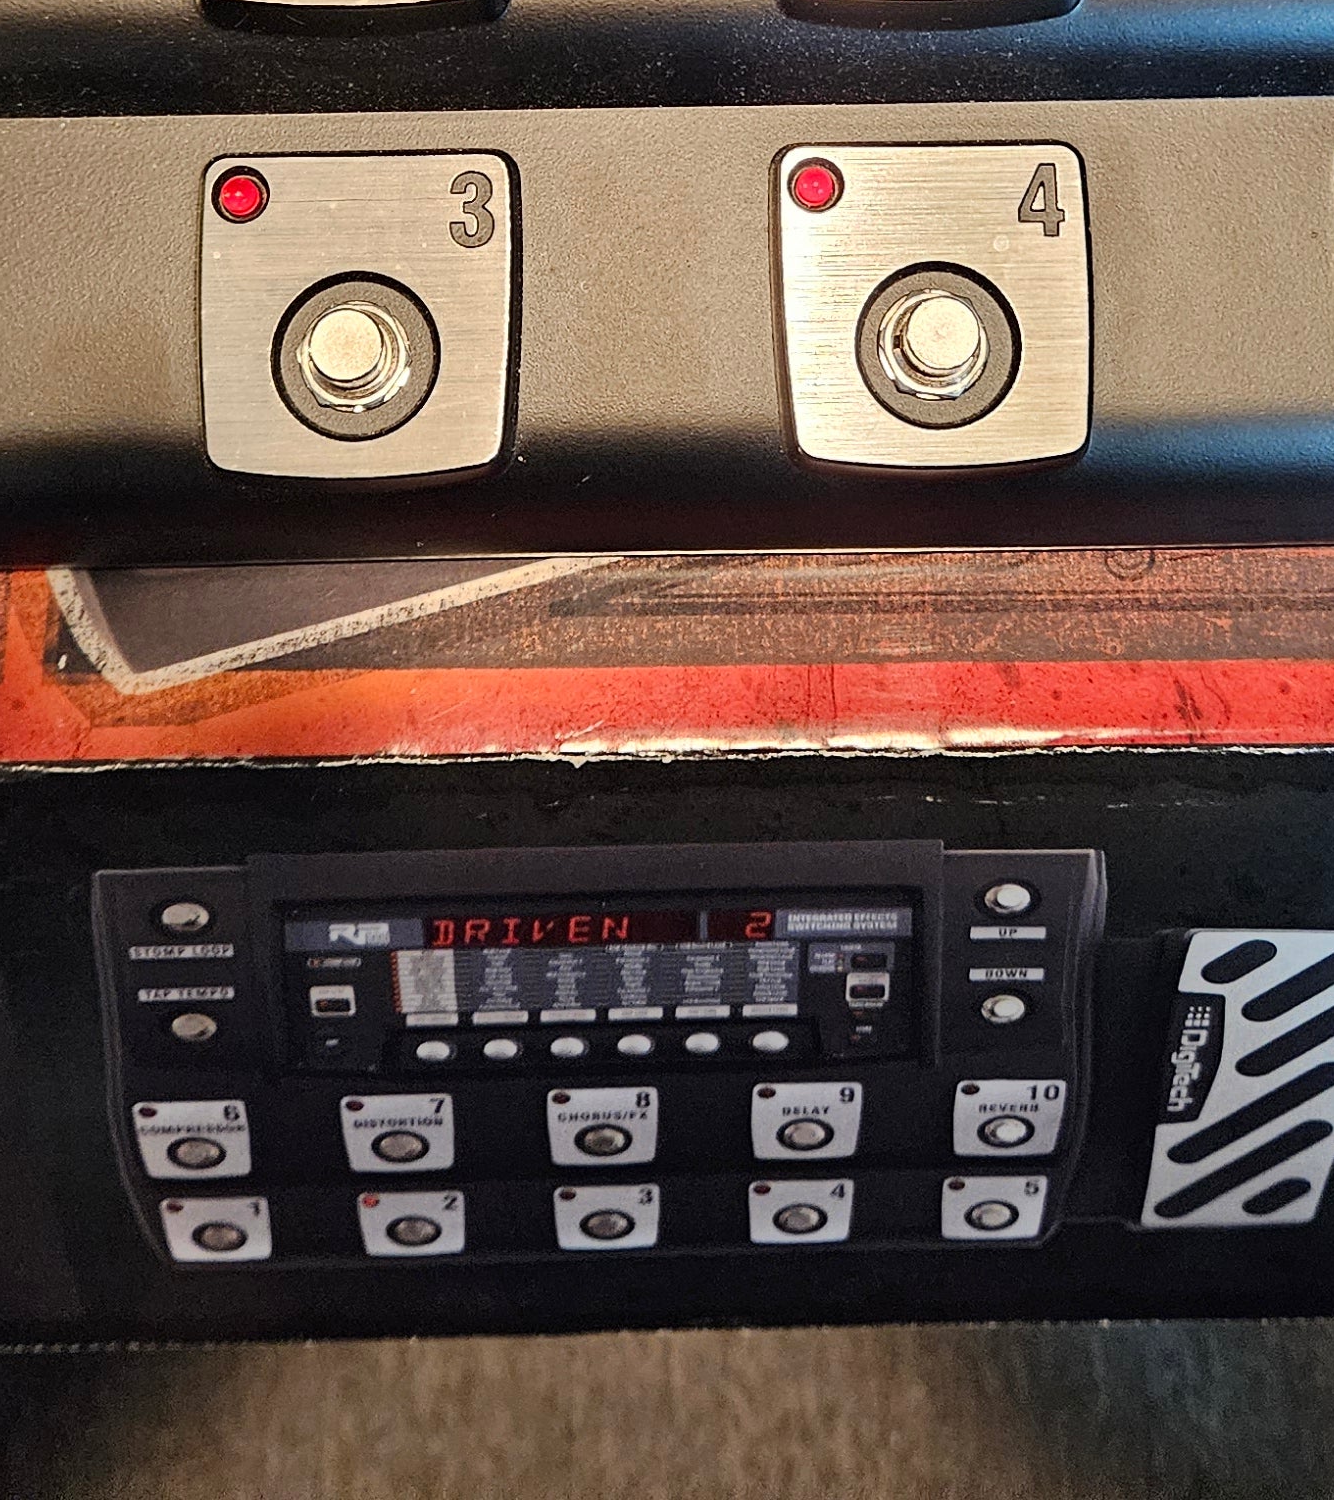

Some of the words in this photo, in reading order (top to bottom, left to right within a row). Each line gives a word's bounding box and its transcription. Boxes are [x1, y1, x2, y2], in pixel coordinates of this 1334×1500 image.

[1018, 163, 1065, 237] 4
[449, 172, 495, 248] 3
[432, 916, 630, 947] DRIVEN
[745, 912, 771, 939] 2
[997, 928, 1017, 938] UP
[984, 968, 1028, 978] DOWN
[839, 1087, 855, 1103] 9
[1028, 1084, 1060, 1100] 10
[430, 1098, 445, 1113] 7
[782, 1106, 830, 1115] DELAY
